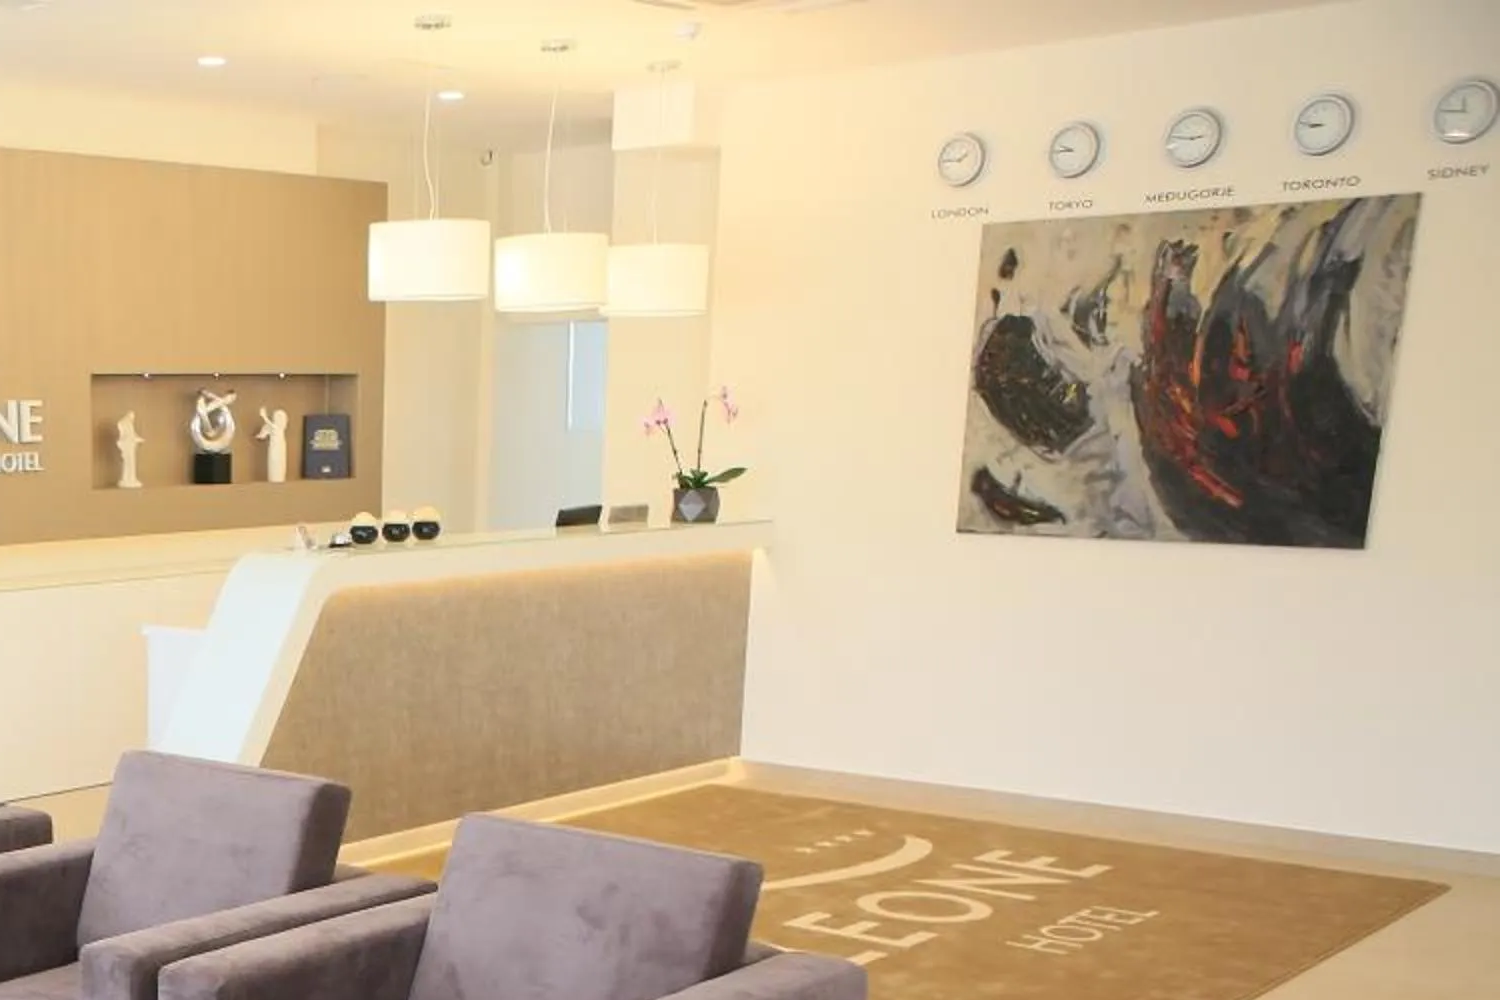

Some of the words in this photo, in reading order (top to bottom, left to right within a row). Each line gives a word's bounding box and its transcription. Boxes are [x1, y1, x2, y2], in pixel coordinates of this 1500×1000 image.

[1427, 164, 1490, 181] SIDNEY
[1283, 174, 1362, 191] TORONTO
[931, 206, 990, 219] LONDON
[1049, 199, 1093, 211] TOKYO
[783, 849, 1114, 966] EONE
[1005, 904, 1161, 955] HOTEL
